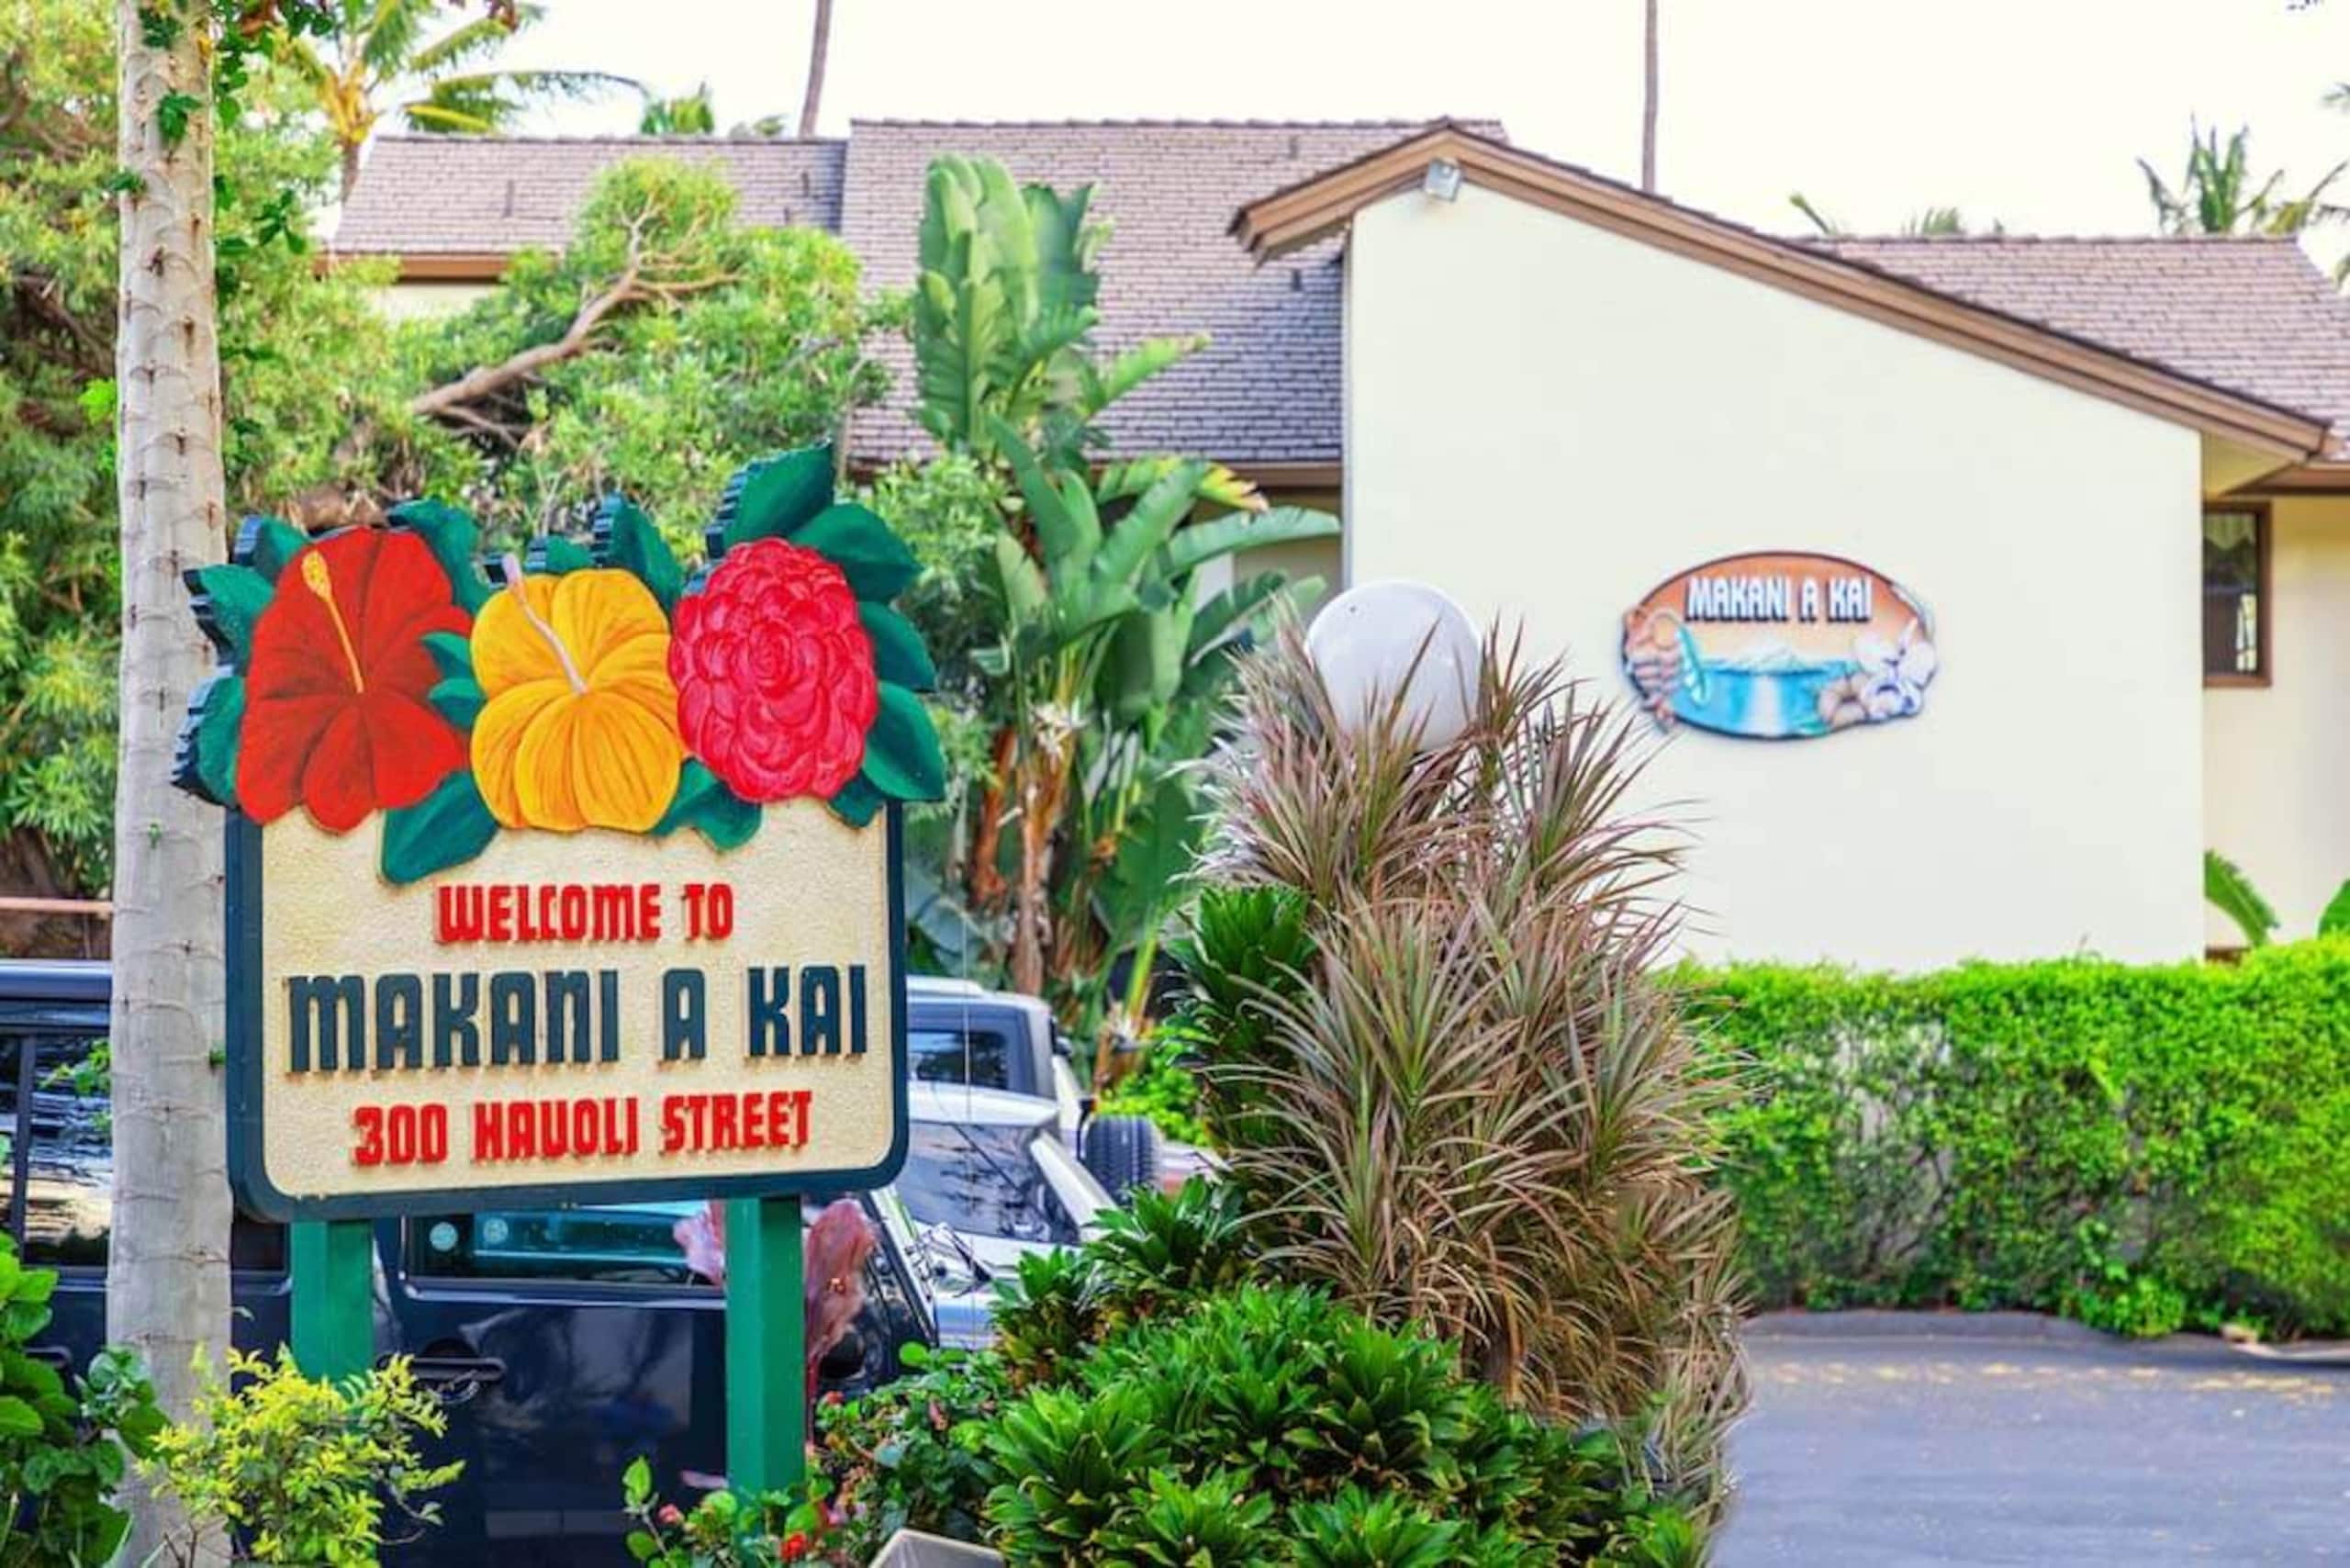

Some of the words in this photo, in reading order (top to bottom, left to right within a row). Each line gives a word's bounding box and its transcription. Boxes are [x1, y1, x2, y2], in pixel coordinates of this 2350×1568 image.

[1685, 576, 1791, 622] MAKANI
[1799, 577, 1820, 622] A
[1827, 576, 1874, 622] KAI
[436, 883, 662, 943] WELCOME
[685, 882, 734, 941] TO
[285, 969, 620, 1071] MAKANI
[660, 969, 706, 1059] A
[747, 965, 868, 1056] KAI
[353, 1104, 449, 1166] 300
[473, 1097, 640, 1159] HAUOLI
[661, 1091, 812, 1153] STREET
